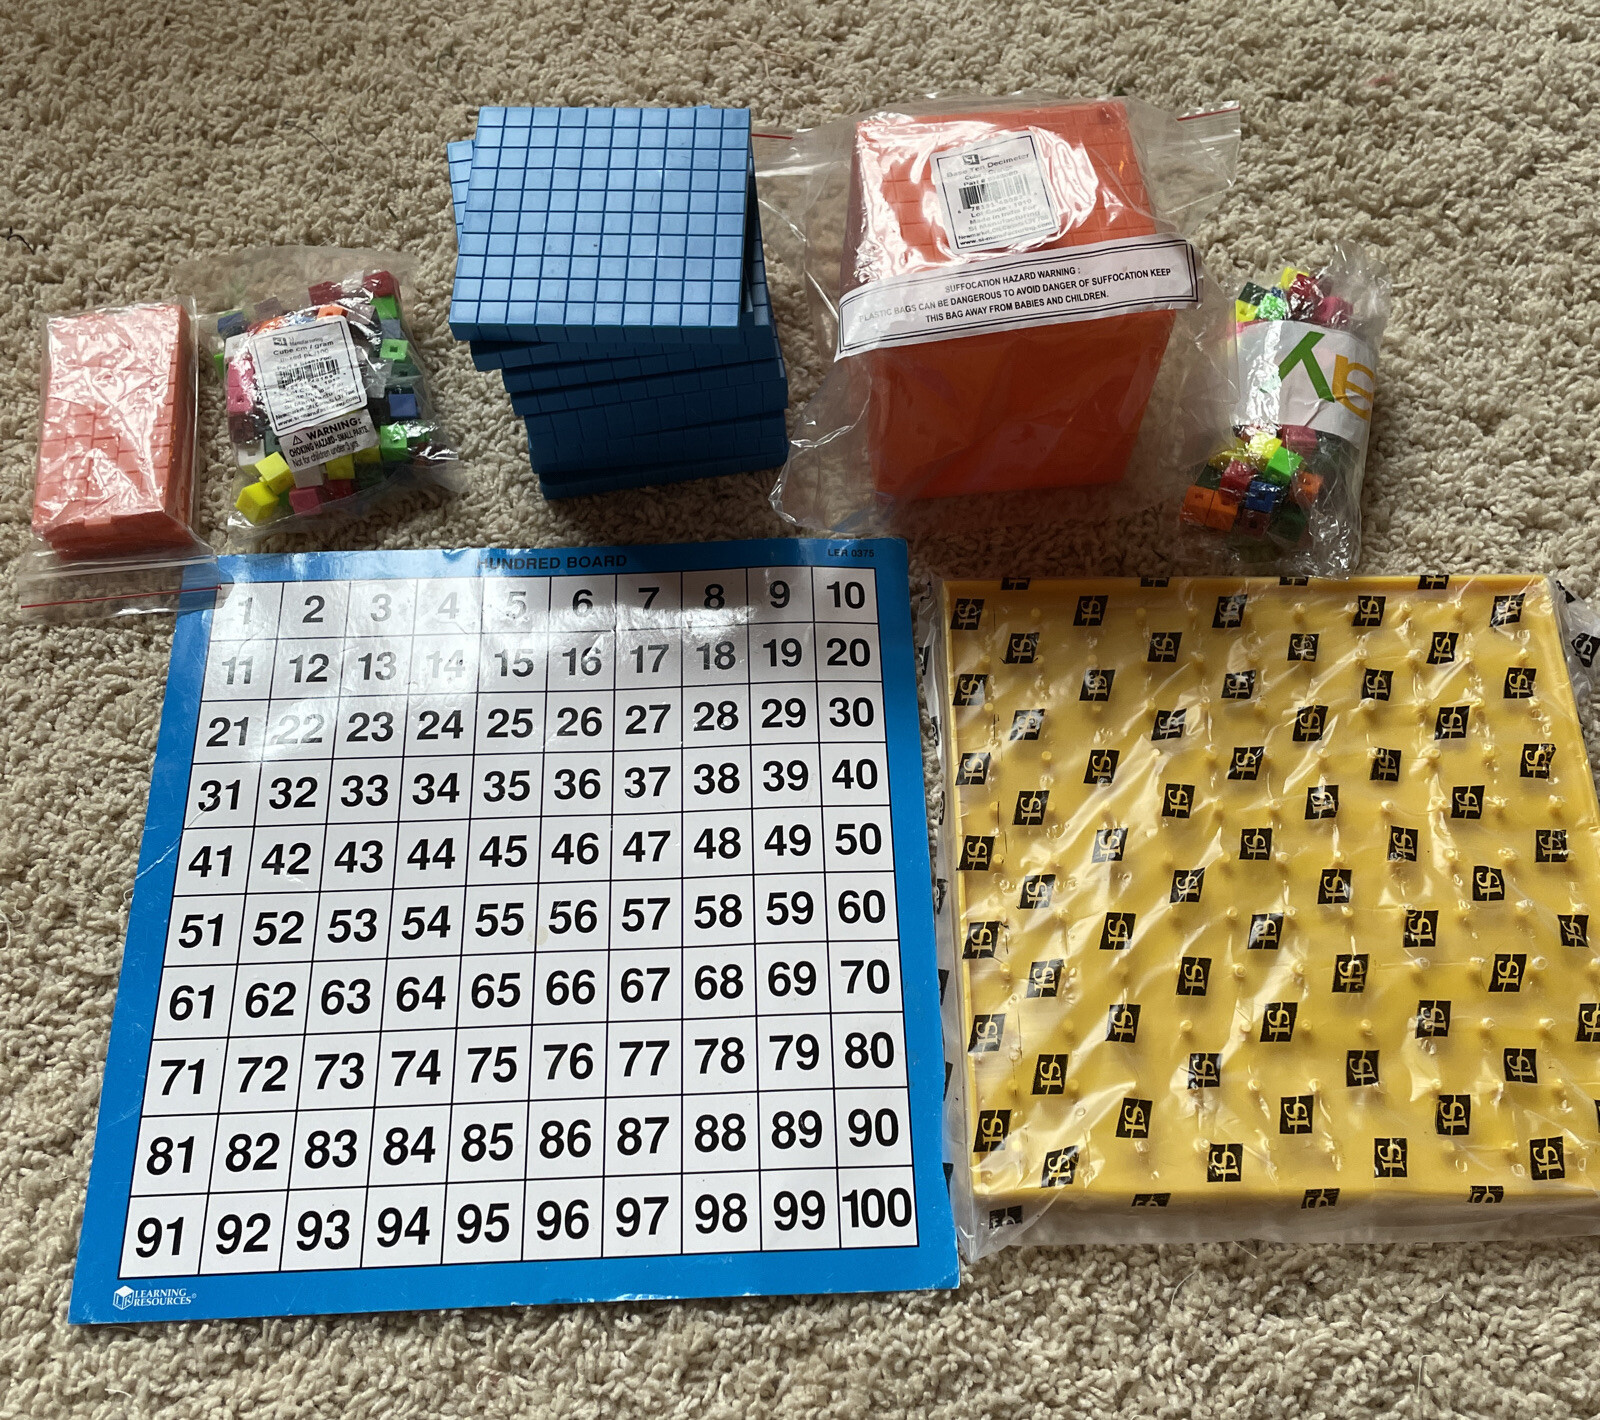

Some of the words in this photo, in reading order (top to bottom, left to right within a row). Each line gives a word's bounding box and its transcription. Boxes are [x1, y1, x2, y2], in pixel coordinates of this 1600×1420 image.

[987, 153, 1029, 167] Decimeter
[858, 308, 892, 321] PLASTIC
[894, 304, 916, 314] BAGS
[918, 301, 935, 310] CAN
[937, 298, 949, 307] BE
[950, 291, 1001, 305] DANGEROUS
[1003, 288, 1015, 297] TO
[1015, 285, 1040, 295] AVOID
[1042, 280, 1077, 292] DANGER
[1080, 278, 1089, 287] OF
[1091, 269, 1148, 285] SUFFOCATION
[1150, 266, 1171, 278] KEEP
[944, 278, 999, 293] SUFFOCATION
[1002, 271, 1036, 283] HAZARD
[1038, 266, 1075, 278] WARNING
[925, 312, 943, 322] THIS
[945, 309, 963, 319] BAG
[964, 306, 987, 316] AWAY
[989, 302, 1012, 313] FROM
[1015, 298, 1044, 309] BABIES
[1046, 295, 1062, 305] AND
[1065, 289, 1108, 303] CHILDREN.
[314, 340, 333, 348] gram
[288, 442, 313, 456] CHOKING
[337, 430, 352, 441] SMALL
[306, 416, 361, 440] WARNING:
[292, 457, 302, 466] Not
[310, 448, 329, 460] children
[330, 443, 345, 454] under
[478, 557, 560, 570] HUNDRED
[567, 555, 627, 568] BOARD
[851, 549, 875, 557] 0375
[302, 595, 326, 623] 2
[573, 589, 593, 618] 6
[638, 587, 660, 613] 7
[704, 584, 726, 612] 8
[769, 581, 791, 609] 9
[827, 581, 865, 609] 10
[289, 654, 330, 683] 12
[358, 651, 398, 681] 13
[495, 651, 535, 678] 15
[562, 648, 602, 676] 16
[631, 644, 669, 673] 17
[696, 641, 736, 670] 18
[763, 638, 802, 667] 19
[827, 638, 870, 667] 20
[347, 712, 393, 742] 23
[487, 709, 533, 738] 25
[626, 704, 670, 734] 27
[762, 698, 806, 728] 29
[830, 697, 874, 727] 30
[206, 717, 248, 747] 21
[484, 771, 530, 802] 35
[625, 766, 670, 798] 37
[763, 760, 808, 791] 39
[832, 759, 877, 789] 40
[198, 780, 240, 811] 31
[269, 777, 317, 809] 32
[341, 775, 388, 807] 33
[480, 835, 527, 867] 45
[623, 831, 670, 862] 47
[765, 824, 811, 856] 49
[836, 823, 881, 855] 50
[189, 846, 232, 877] 41
[261, 843, 311, 875] 42
[335, 841, 383, 873] 43
[476, 903, 524, 937] 55
[622, 898, 670, 931] 57
[767, 891, 813, 925] 59
[839, 890, 885, 923] 60
[179, 914, 223, 948] 51
[253, 911, 304, 946] 52
[328, 909, 377, 943] 53
[472, 973, 520, 1008] 65
[621, 968, 670, 1003] 67
[768, 961, 816, 996] 69
[841, 960, 889, 994] 70
[170, 985, 214, 1020] 61
[246, 982, 296, 1018] 62
[321, 979, 370, 1015] 63
[468, 1046, 516, 1083] 75
[620, 1040, 669, 1076] 77
[770, 1034, 819, 1070] 79
[845, 1032, 894, 1069] 80
[161, 1059, 204, 1095] 71
[238, 1056, 288, 1092] 72
[315, 1053, 364, 1089] 73
[462, 1123, 513, 1162] 85
[618, 1117, 669, 1155] 87
[772, 1110, 822, 1149] 89
[848, 1108, 898, 1147] 90
[147, 1136, 194, 1175] 81
[226, 1133, 279, 1172] 82
[305, 1130, 357, 1169] 83
[457, 1203, 509, 1243] 95
[617, 1197, 668, 1237] 97
[774, 1190, 825, 1230] 99
[842, 1188, 911, 1228] 100
[136, 1217, 183, 1257] 91
[216, 1213, 270, 1254] 92
[297, 1210, 349, 1251] 93
[133, 1296, 192, 1307] RESOURCES
[135, 1288, 187, 1298] LEARNING
